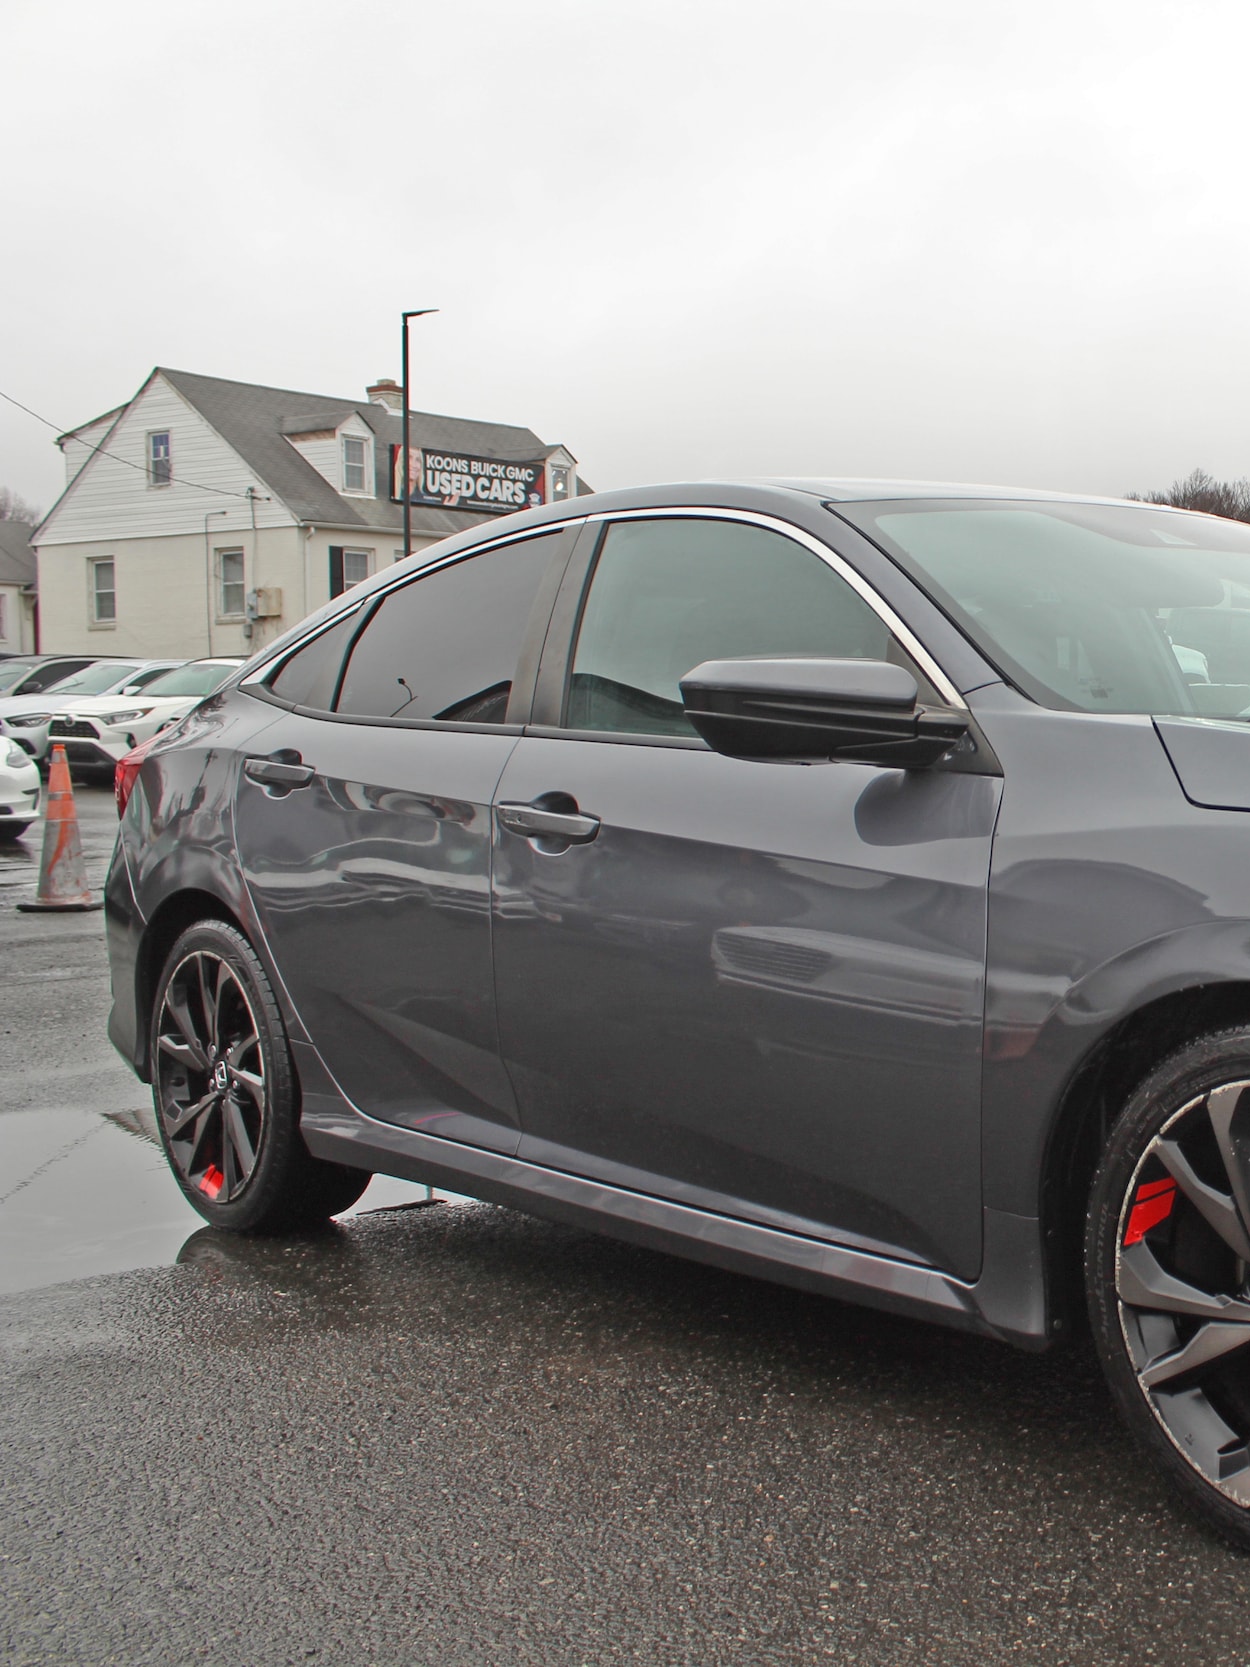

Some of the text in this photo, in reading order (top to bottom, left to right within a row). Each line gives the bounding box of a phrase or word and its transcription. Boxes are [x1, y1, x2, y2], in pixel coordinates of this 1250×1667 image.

[426, 454, 535, 482] KOONS BUICK GMC
[426, 470, 526, 503] USED CARS
